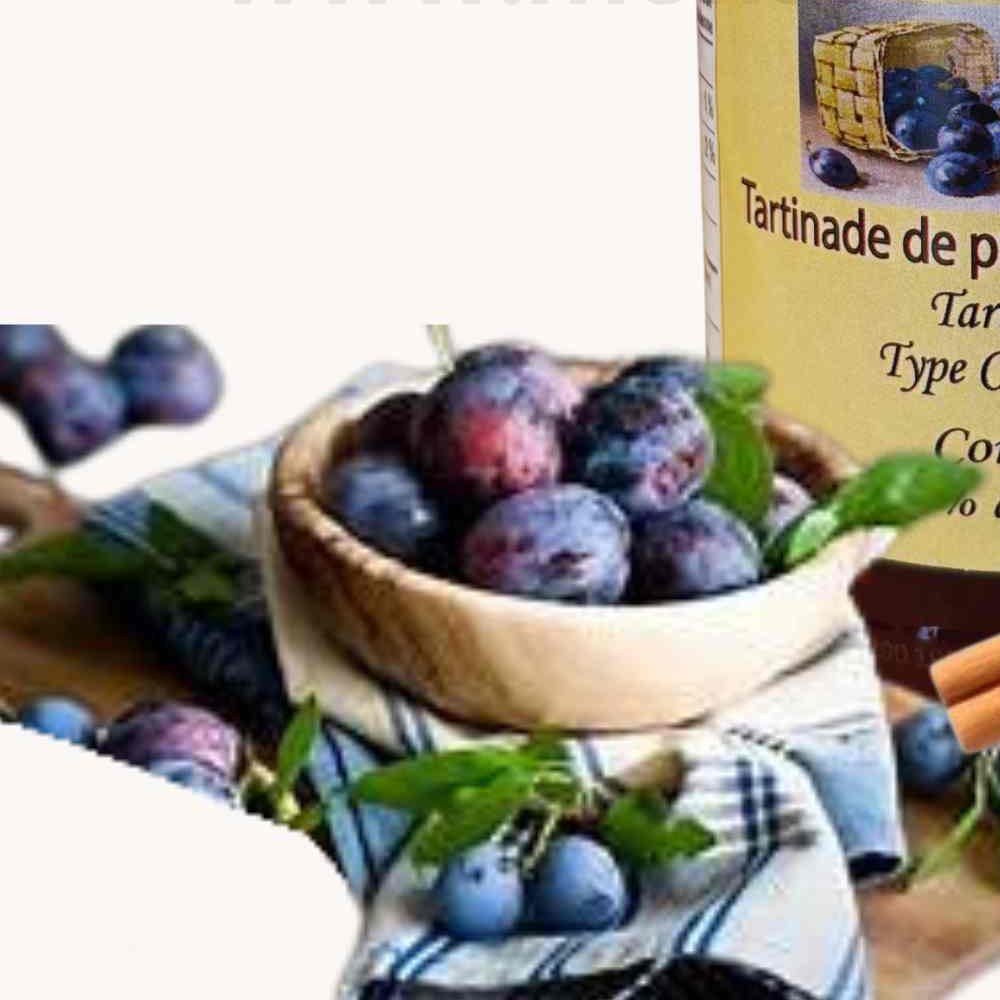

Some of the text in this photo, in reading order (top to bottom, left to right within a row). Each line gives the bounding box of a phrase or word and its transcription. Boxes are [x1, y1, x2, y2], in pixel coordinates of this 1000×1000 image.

[740, 176, 891, 259] Tartinade
[902, 215, 956, 266] de
[879, 341, 968, 395] Type
